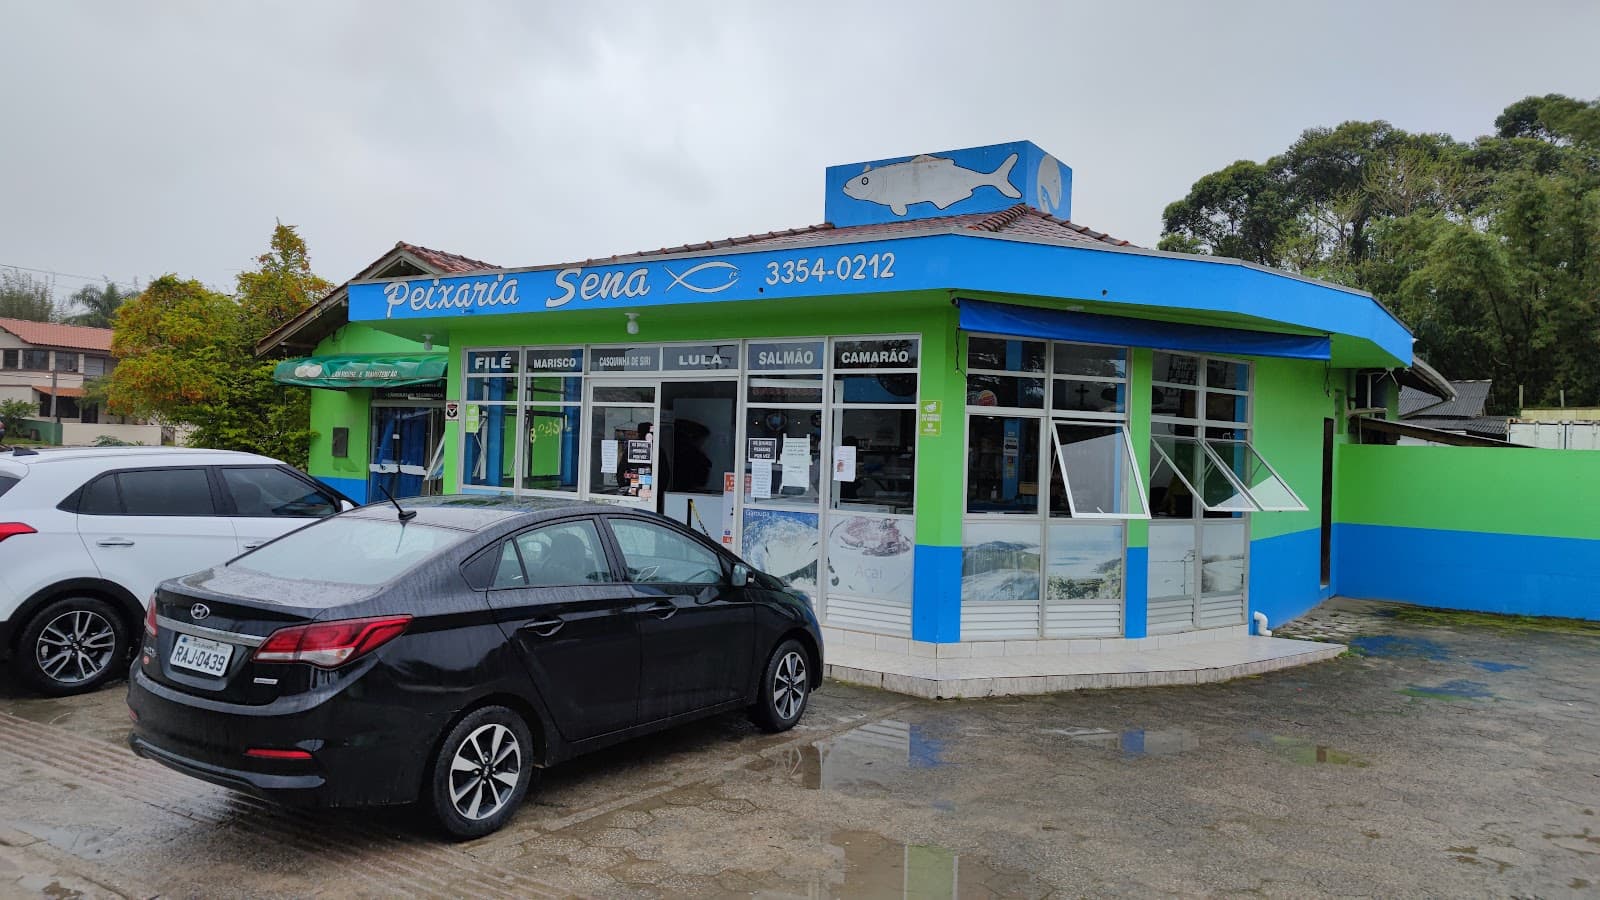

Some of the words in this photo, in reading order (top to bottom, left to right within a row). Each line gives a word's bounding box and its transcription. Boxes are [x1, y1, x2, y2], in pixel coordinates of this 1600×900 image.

[765, 252, 896, 286] 3354-0212
[383, 273, 520, 320] Peixaria
[545, 267, 651, 308] Sena
[474, 352, 512, 370] FILÉ
[533, 357, 576, 369] MARISCO
[599, 356, 630, 367] CASQUINHA
[631, 356, 639, 366] DE
[639, 355, 651, 366] SIRI
[678, 353, 722, 366] LULA
[758, 347, 814, 365] SALMÃO
[841, 347, 909, 364] CAMARÃO
[174, 645, 226, 673] RAJ-0439
